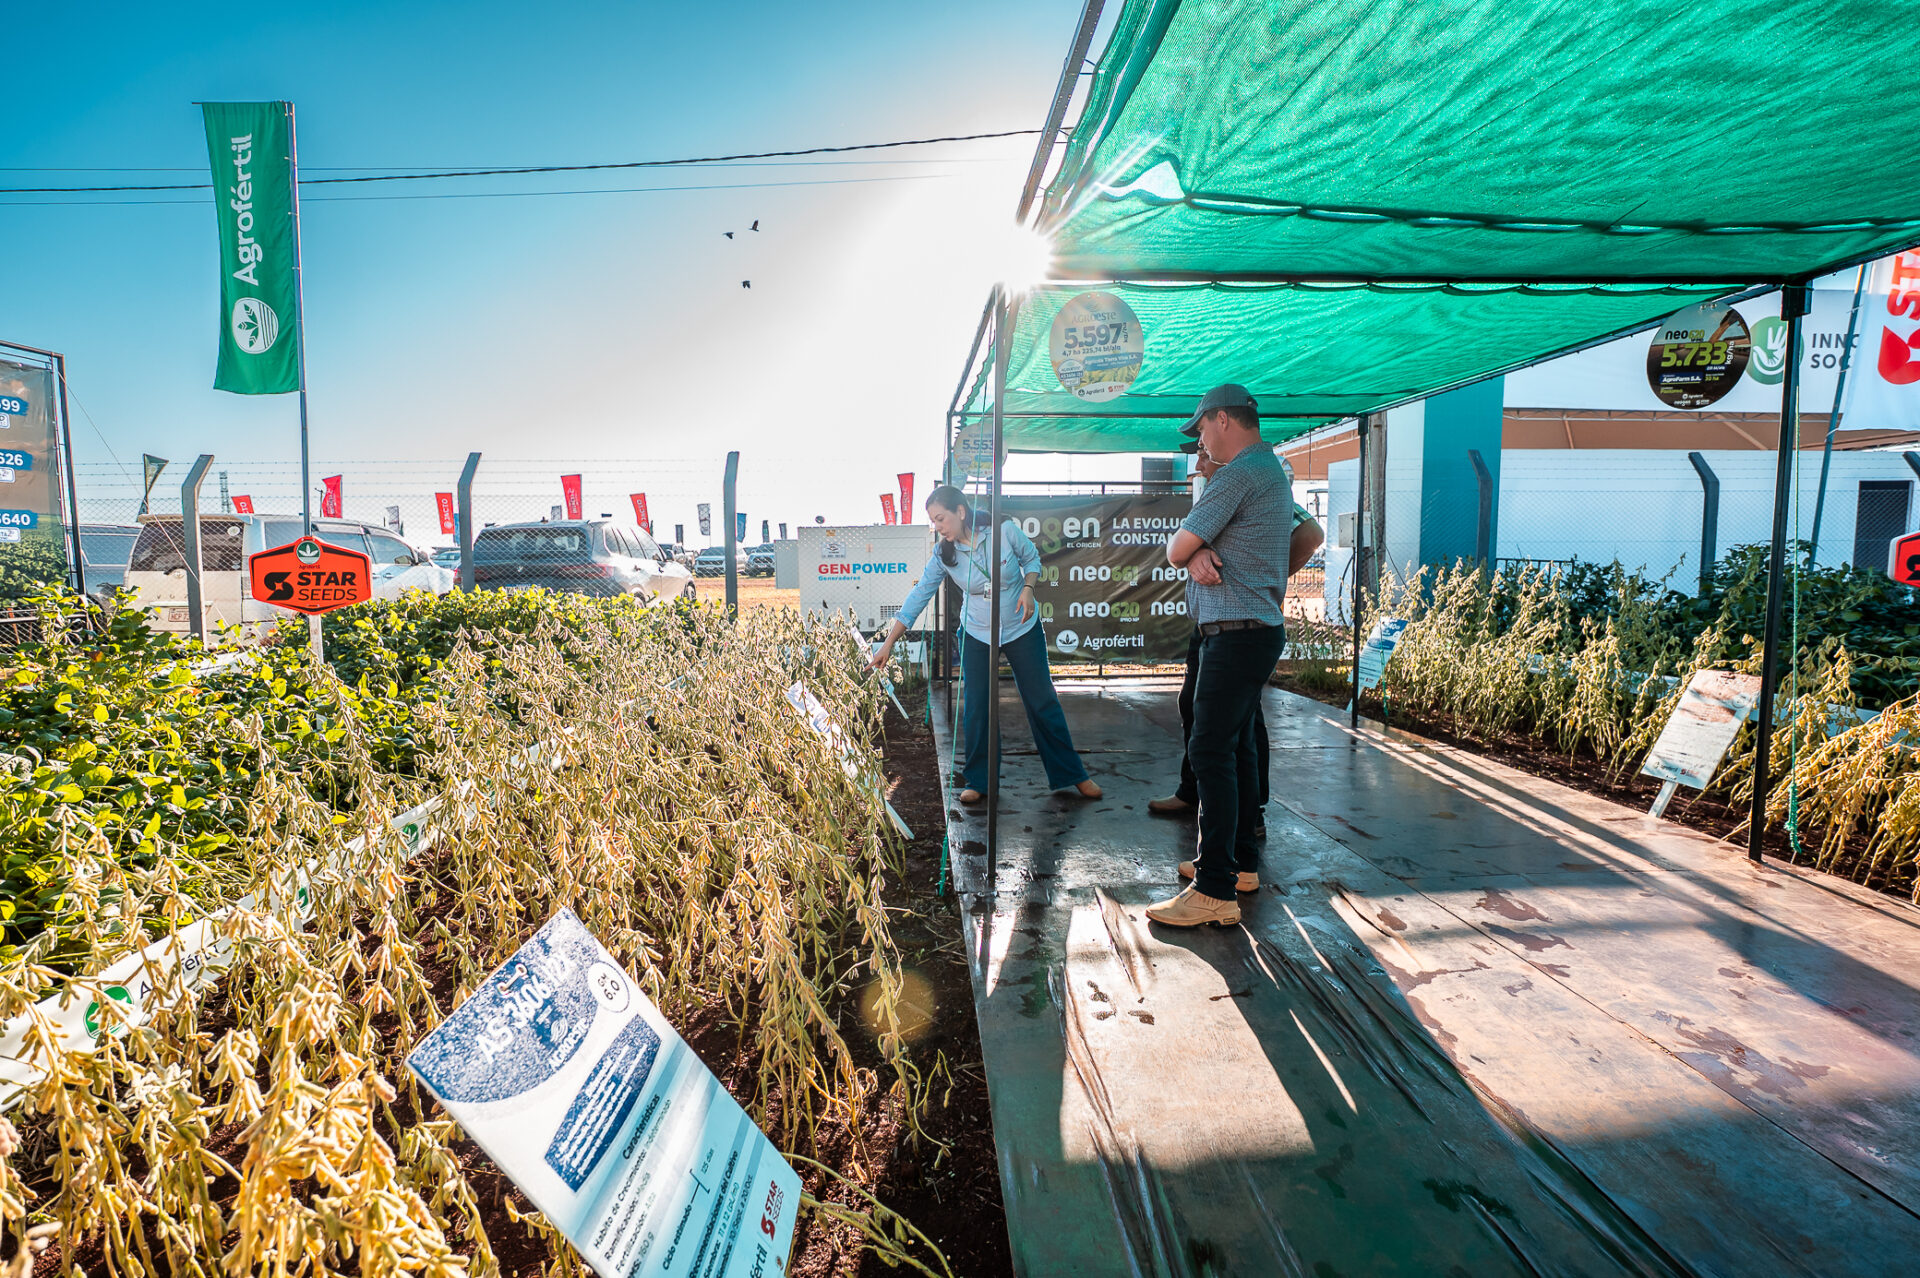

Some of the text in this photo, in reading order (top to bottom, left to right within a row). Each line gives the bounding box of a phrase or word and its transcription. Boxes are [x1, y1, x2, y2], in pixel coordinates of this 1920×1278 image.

[231, 133, 263, 286] Agrofértil
[1887, 246, 1920, 321] ST
[1064, 322, 1123, 349] 5.597
[1660, 341, 1728, 368] 5.733
[0, 398, 20, 413] 99
[0, 513, 31, 526] 640
[1113, 517, 1131, 530] LA
[297, 571, 357, 586] STAR
[298, 588, 358, 601] SEEDS
[1069, 601, 1140, 618] neo620
[1083, 634, 1144, 651] Agrofértil
[604, 980, 620, 1001] 6.0
[475, 1017, 513, 1064] AS
[504, 974, 552, 1029] 3606
[612, 1202, 620, 1216] de
[618, 1149, 647, 1202] Crecimiento:
[765, 1179, 778, 1216] STAR
[772, 1187, 784, 1224] SEEDS
[688, 1150, 738, 1278] Recomendaciones del Cultivo
[662, 1204, 692, 1271] Ciclo estimado
